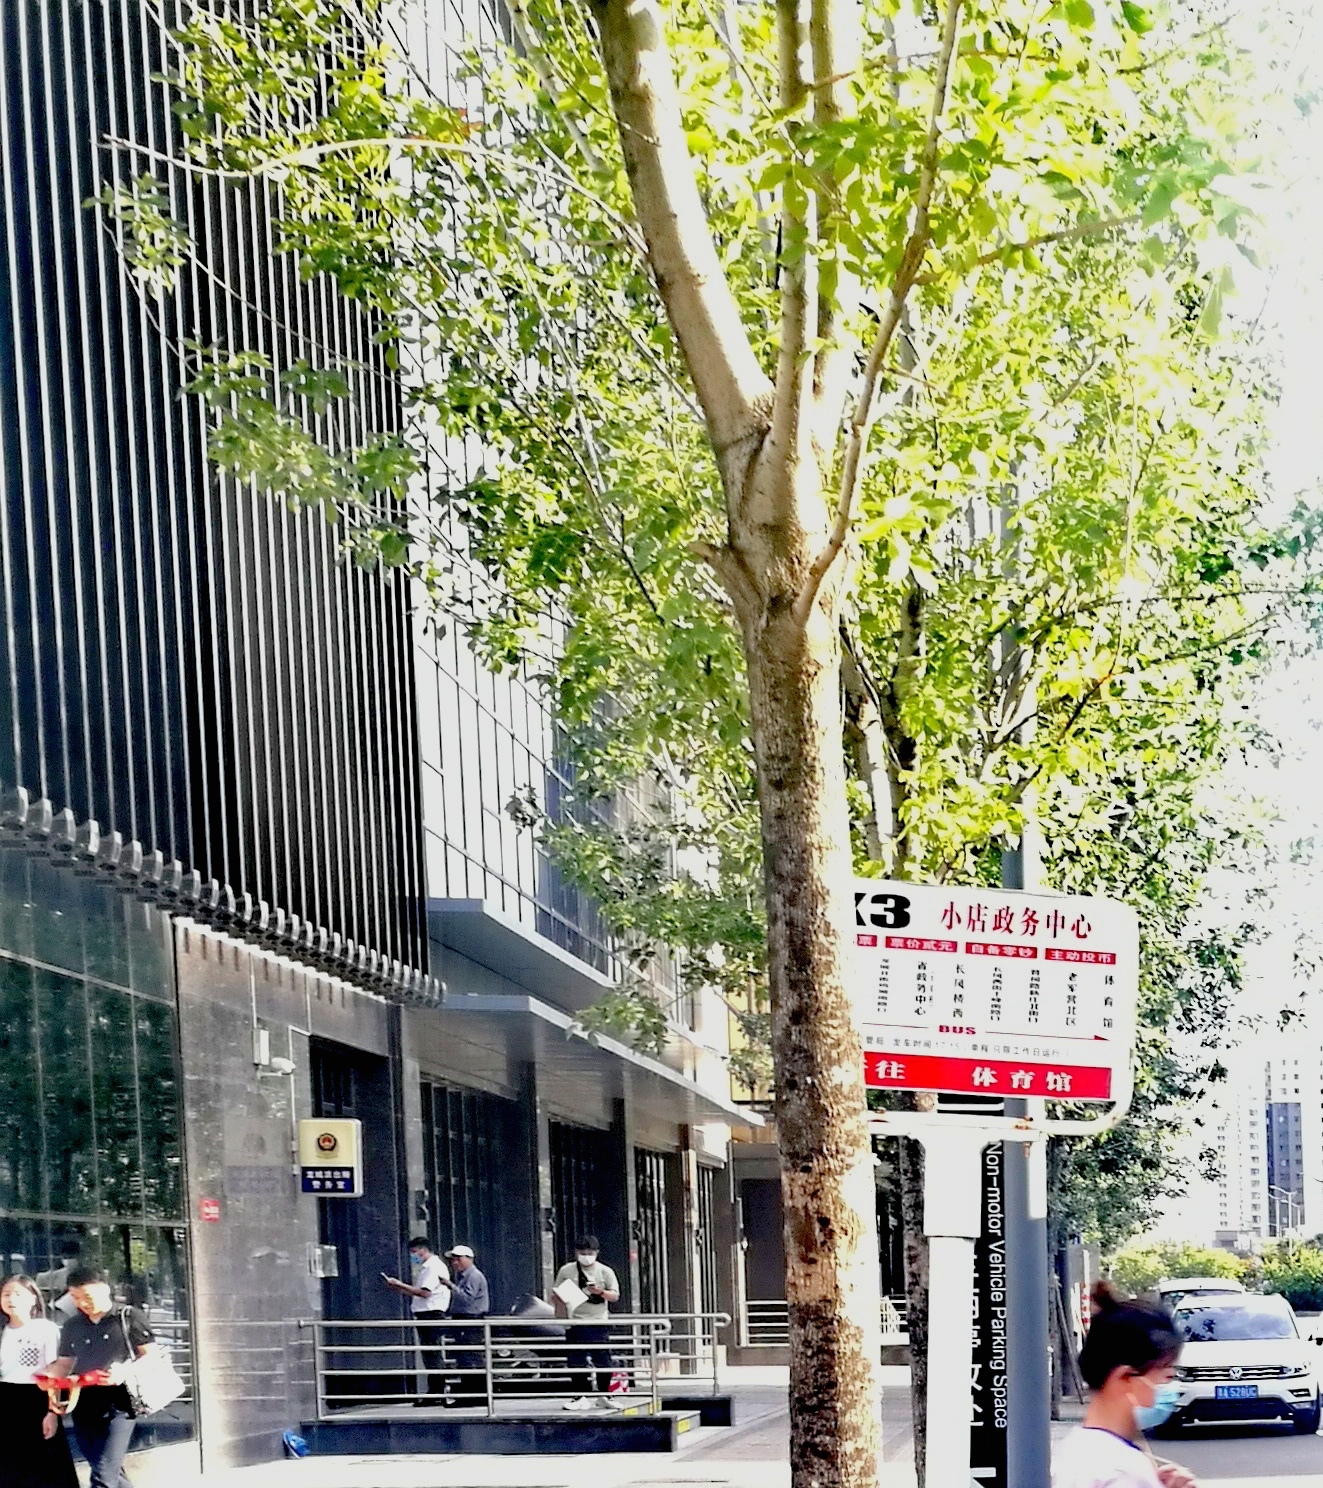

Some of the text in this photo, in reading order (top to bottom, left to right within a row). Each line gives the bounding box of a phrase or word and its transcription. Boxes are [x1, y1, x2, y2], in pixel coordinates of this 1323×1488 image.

[854, 892, 1092, 940] 3 小店政务中心
[889, 937, 954, 952] 票价贰元
[971, 943, 1034, 958] 自备零钞
[1050, 950, 1113, 964] 主动投币
[1103, 974, 1115, 1029] 体育馆
[938, 1024, 977, 1036] BUS
[863, 1059, 1074, 1093] 往 体育馆
[986, 1142, 1008, 1429] Non-motor Vehicle Parking Space
